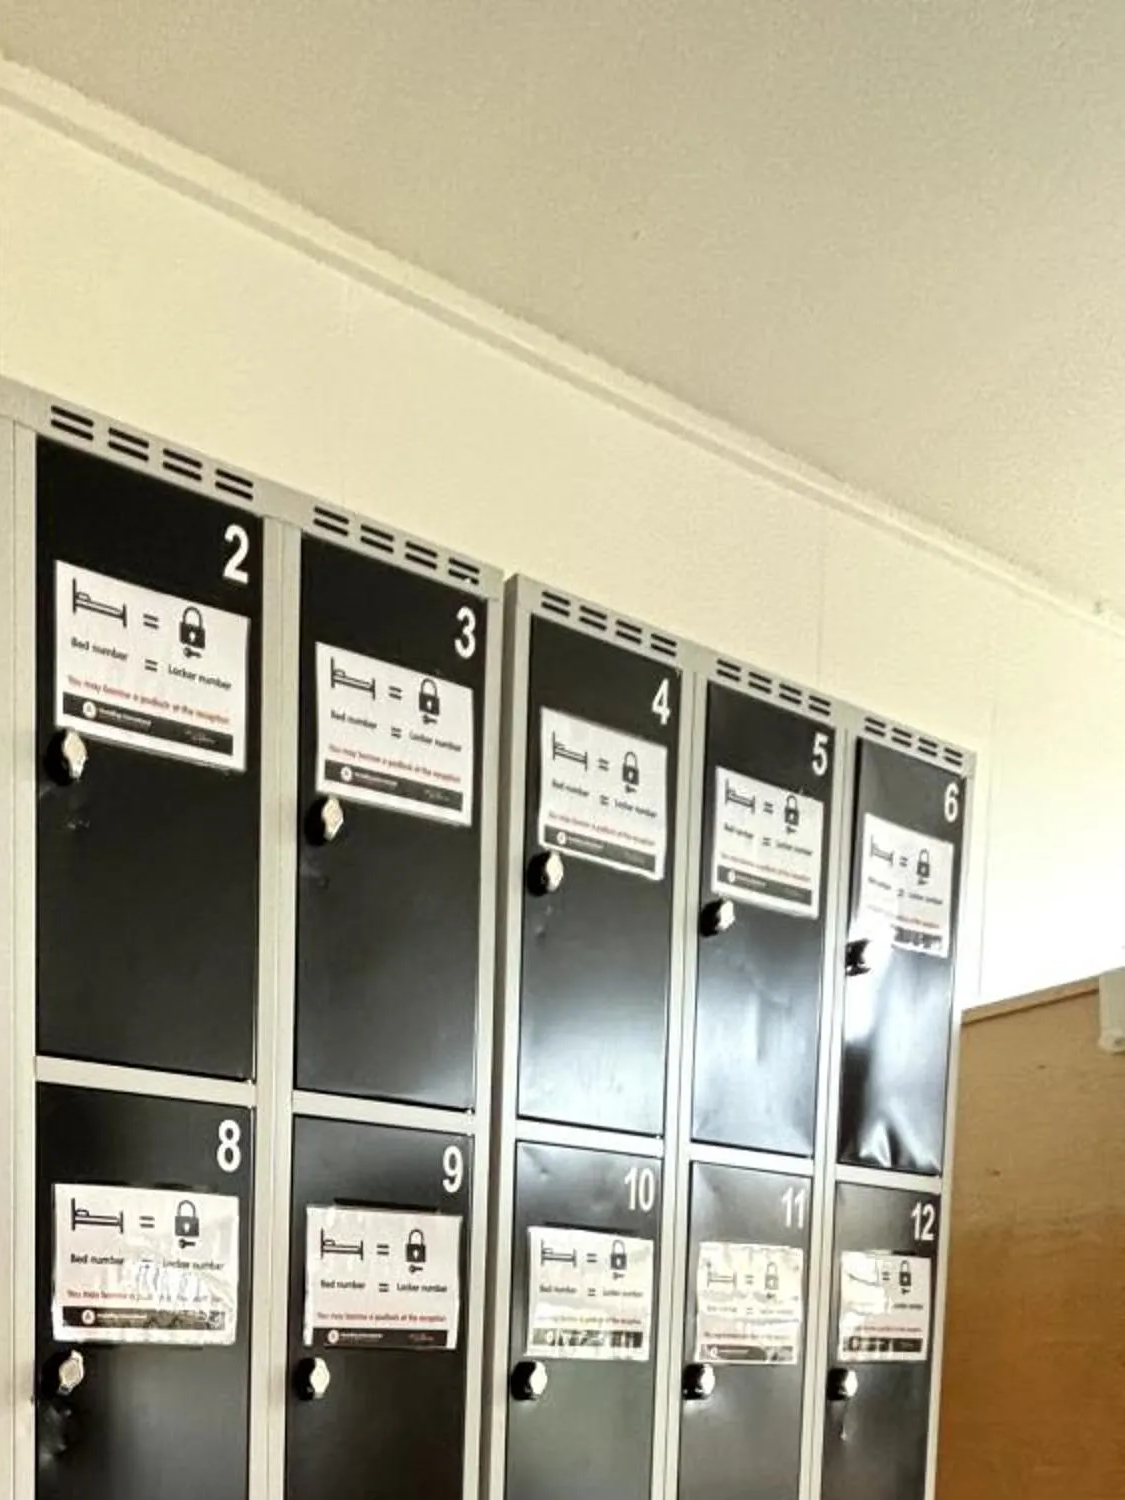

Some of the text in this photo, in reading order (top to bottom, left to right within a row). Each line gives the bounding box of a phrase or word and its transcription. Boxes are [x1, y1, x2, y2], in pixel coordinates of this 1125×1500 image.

[223, 524, 249, 584] 2
[454, 606, 476, 659] 3
[652, 678, 671, 725] 4
[812, 732, 828, 776] 5
[944, 782, 959, 823] 6
[216, 1119, 241, 1172] 8
[442, 1145, 464, 1193] 9
[624, 1167, 655, 1211] 10
[781, 1187, 806, 1229] 11
[911, 1202, 935, 1241] 12
